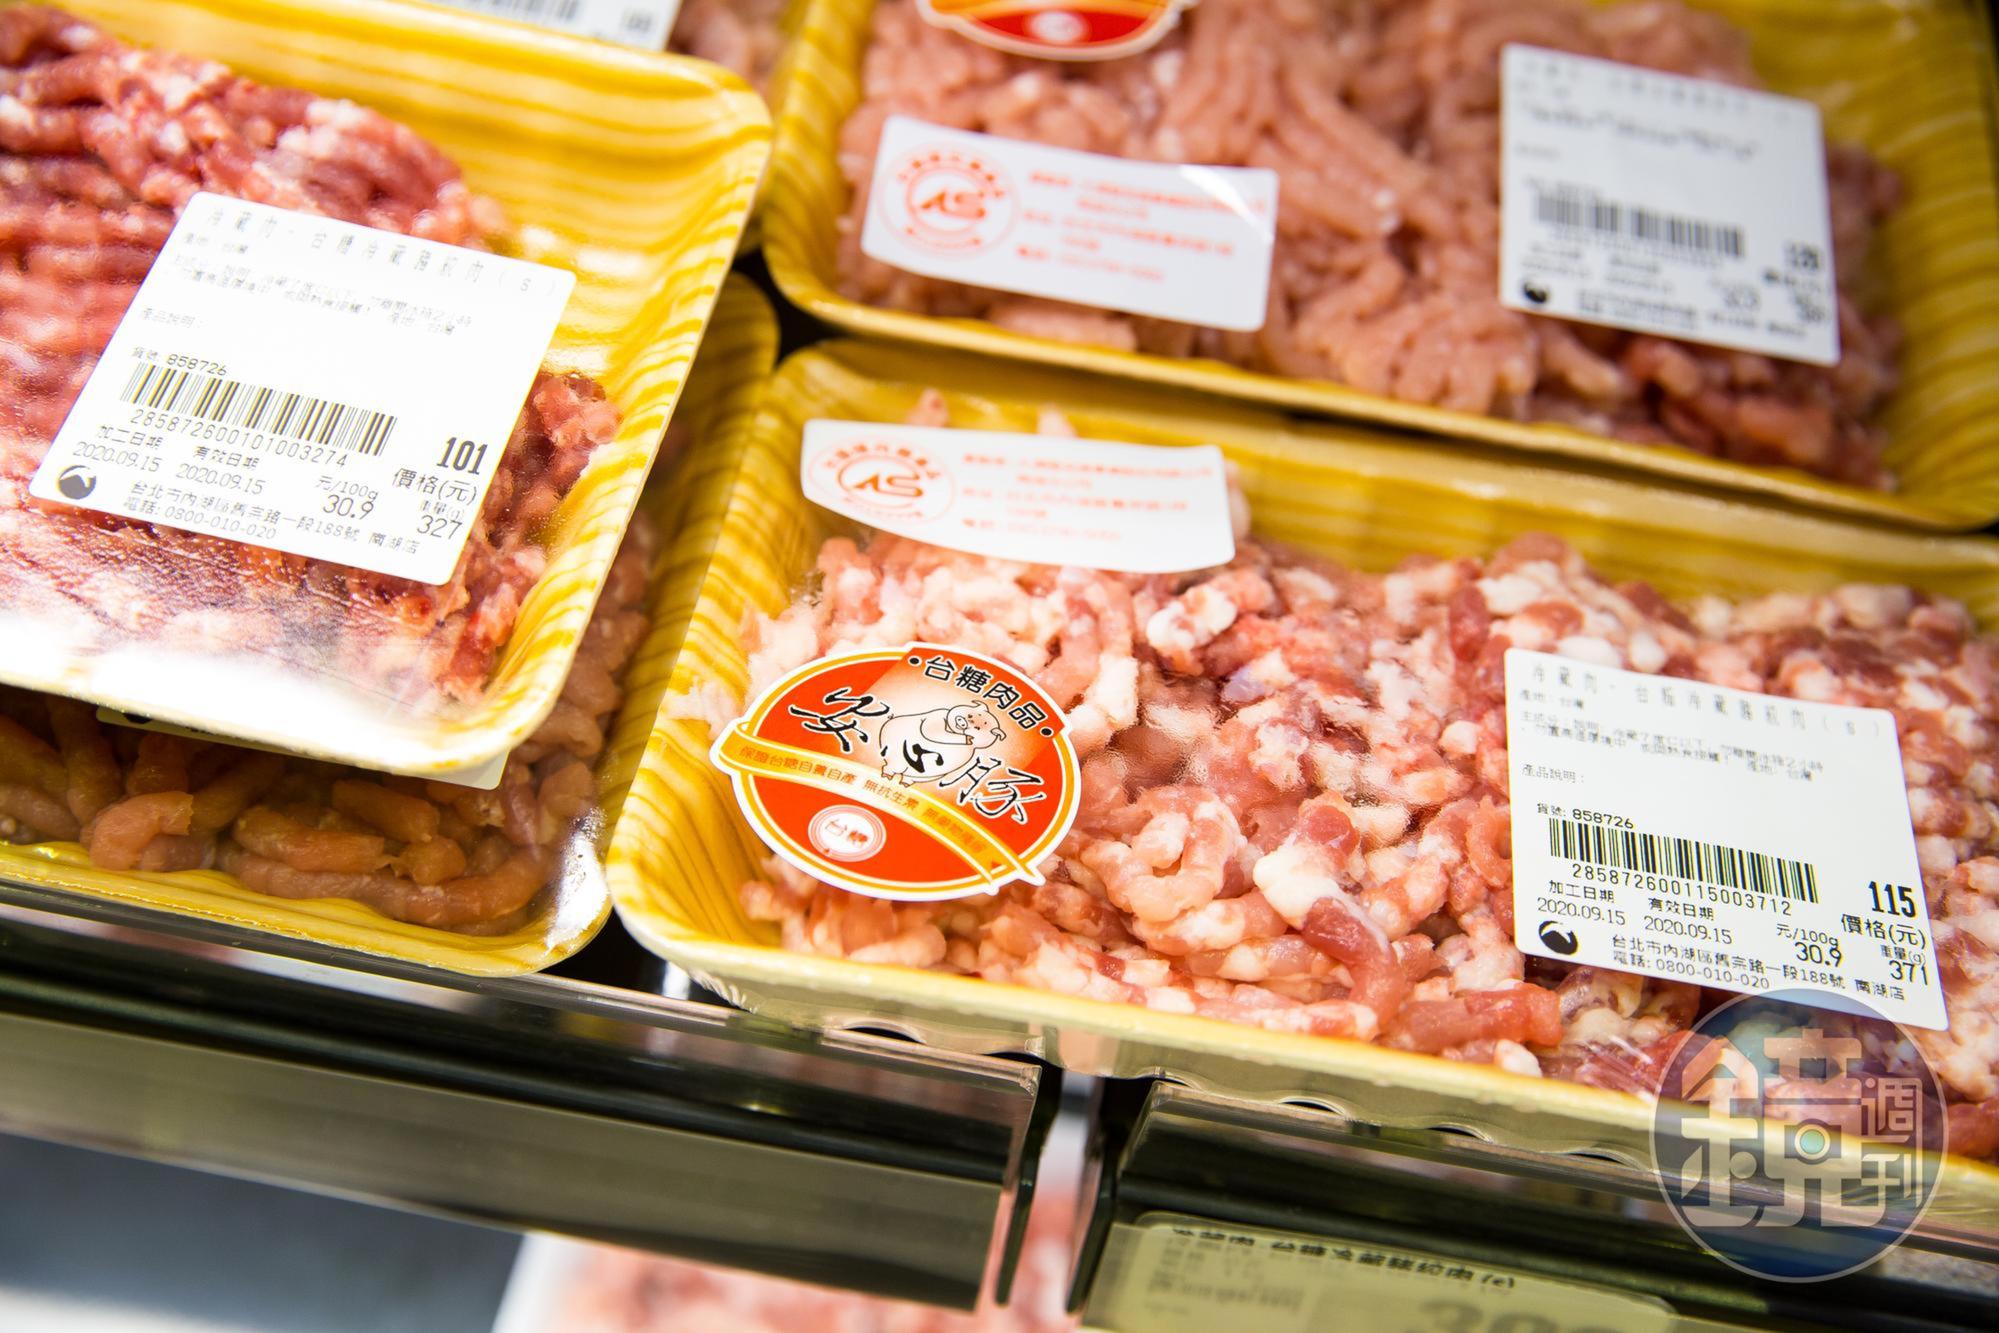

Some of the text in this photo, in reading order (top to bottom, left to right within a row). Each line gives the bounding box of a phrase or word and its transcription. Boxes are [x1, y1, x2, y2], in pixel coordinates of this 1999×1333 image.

[166, 352, 229, 377] 858726
[129, 408, 349, 470] 285872600101003274
[435, 436, 490, 477] 101
[73, 441, 267, 496] 2020.09.15 2020.09.15
[315, 467, 480, 504] 元/100g 價格(元)
[164, 505, 278, 541] 0800-010-020
[322, 493, 376, 521] 30.9
[416, 514, 464, 541] 327
[924, 654, 1047, 730] 台糖肉品
[787, 686, 1047, 824] 安心豚
[1572, 807, 1635, 830] 858726
[1548, 880, 1716, 922] 加工日期 有效日期
[1571, 862, 1793, 917] 285872600115003712
[1868, 881, 1917, 920] 115
[1537, 897, 1733, 945] 2020.09.15 2020.09.15
[1777, 914, 1928, 950] 元/100g 價格(元)
[1794, 941, 1845, 969] 30.9
[1888, 960, 1930, 987] 371
[1656, 959, 1771, 991] 0800-010-020
